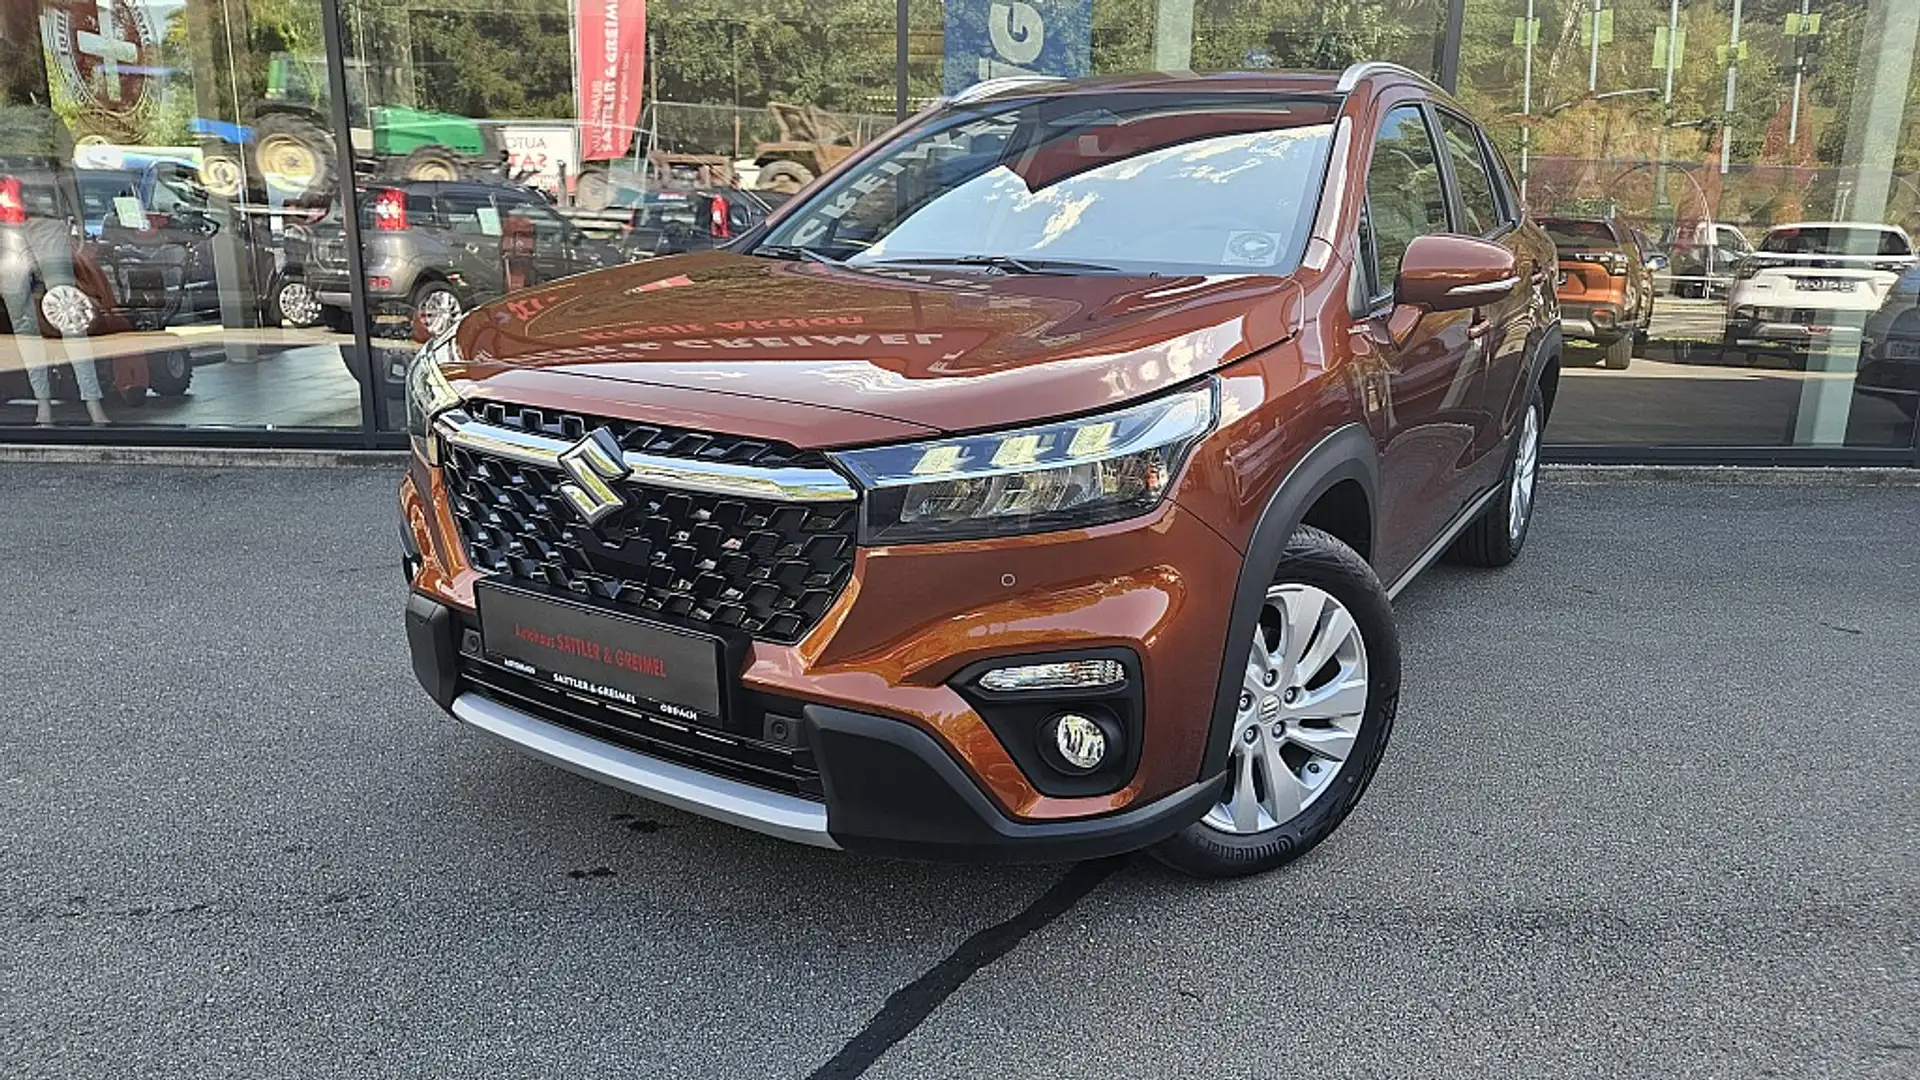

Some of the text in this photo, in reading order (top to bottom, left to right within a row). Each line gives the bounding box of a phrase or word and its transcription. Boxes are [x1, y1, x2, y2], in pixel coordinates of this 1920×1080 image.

[602, 0, 619, 152] SATTLER & GREIM
[556, 633, 601, 661] SATTLER
[603, 647, 613, 664] &
[614, 649, 667, 678] GREIMEL
[553, 673, 588, 691] SATTLER
[597, 685, 637, 705] GREIMEL
